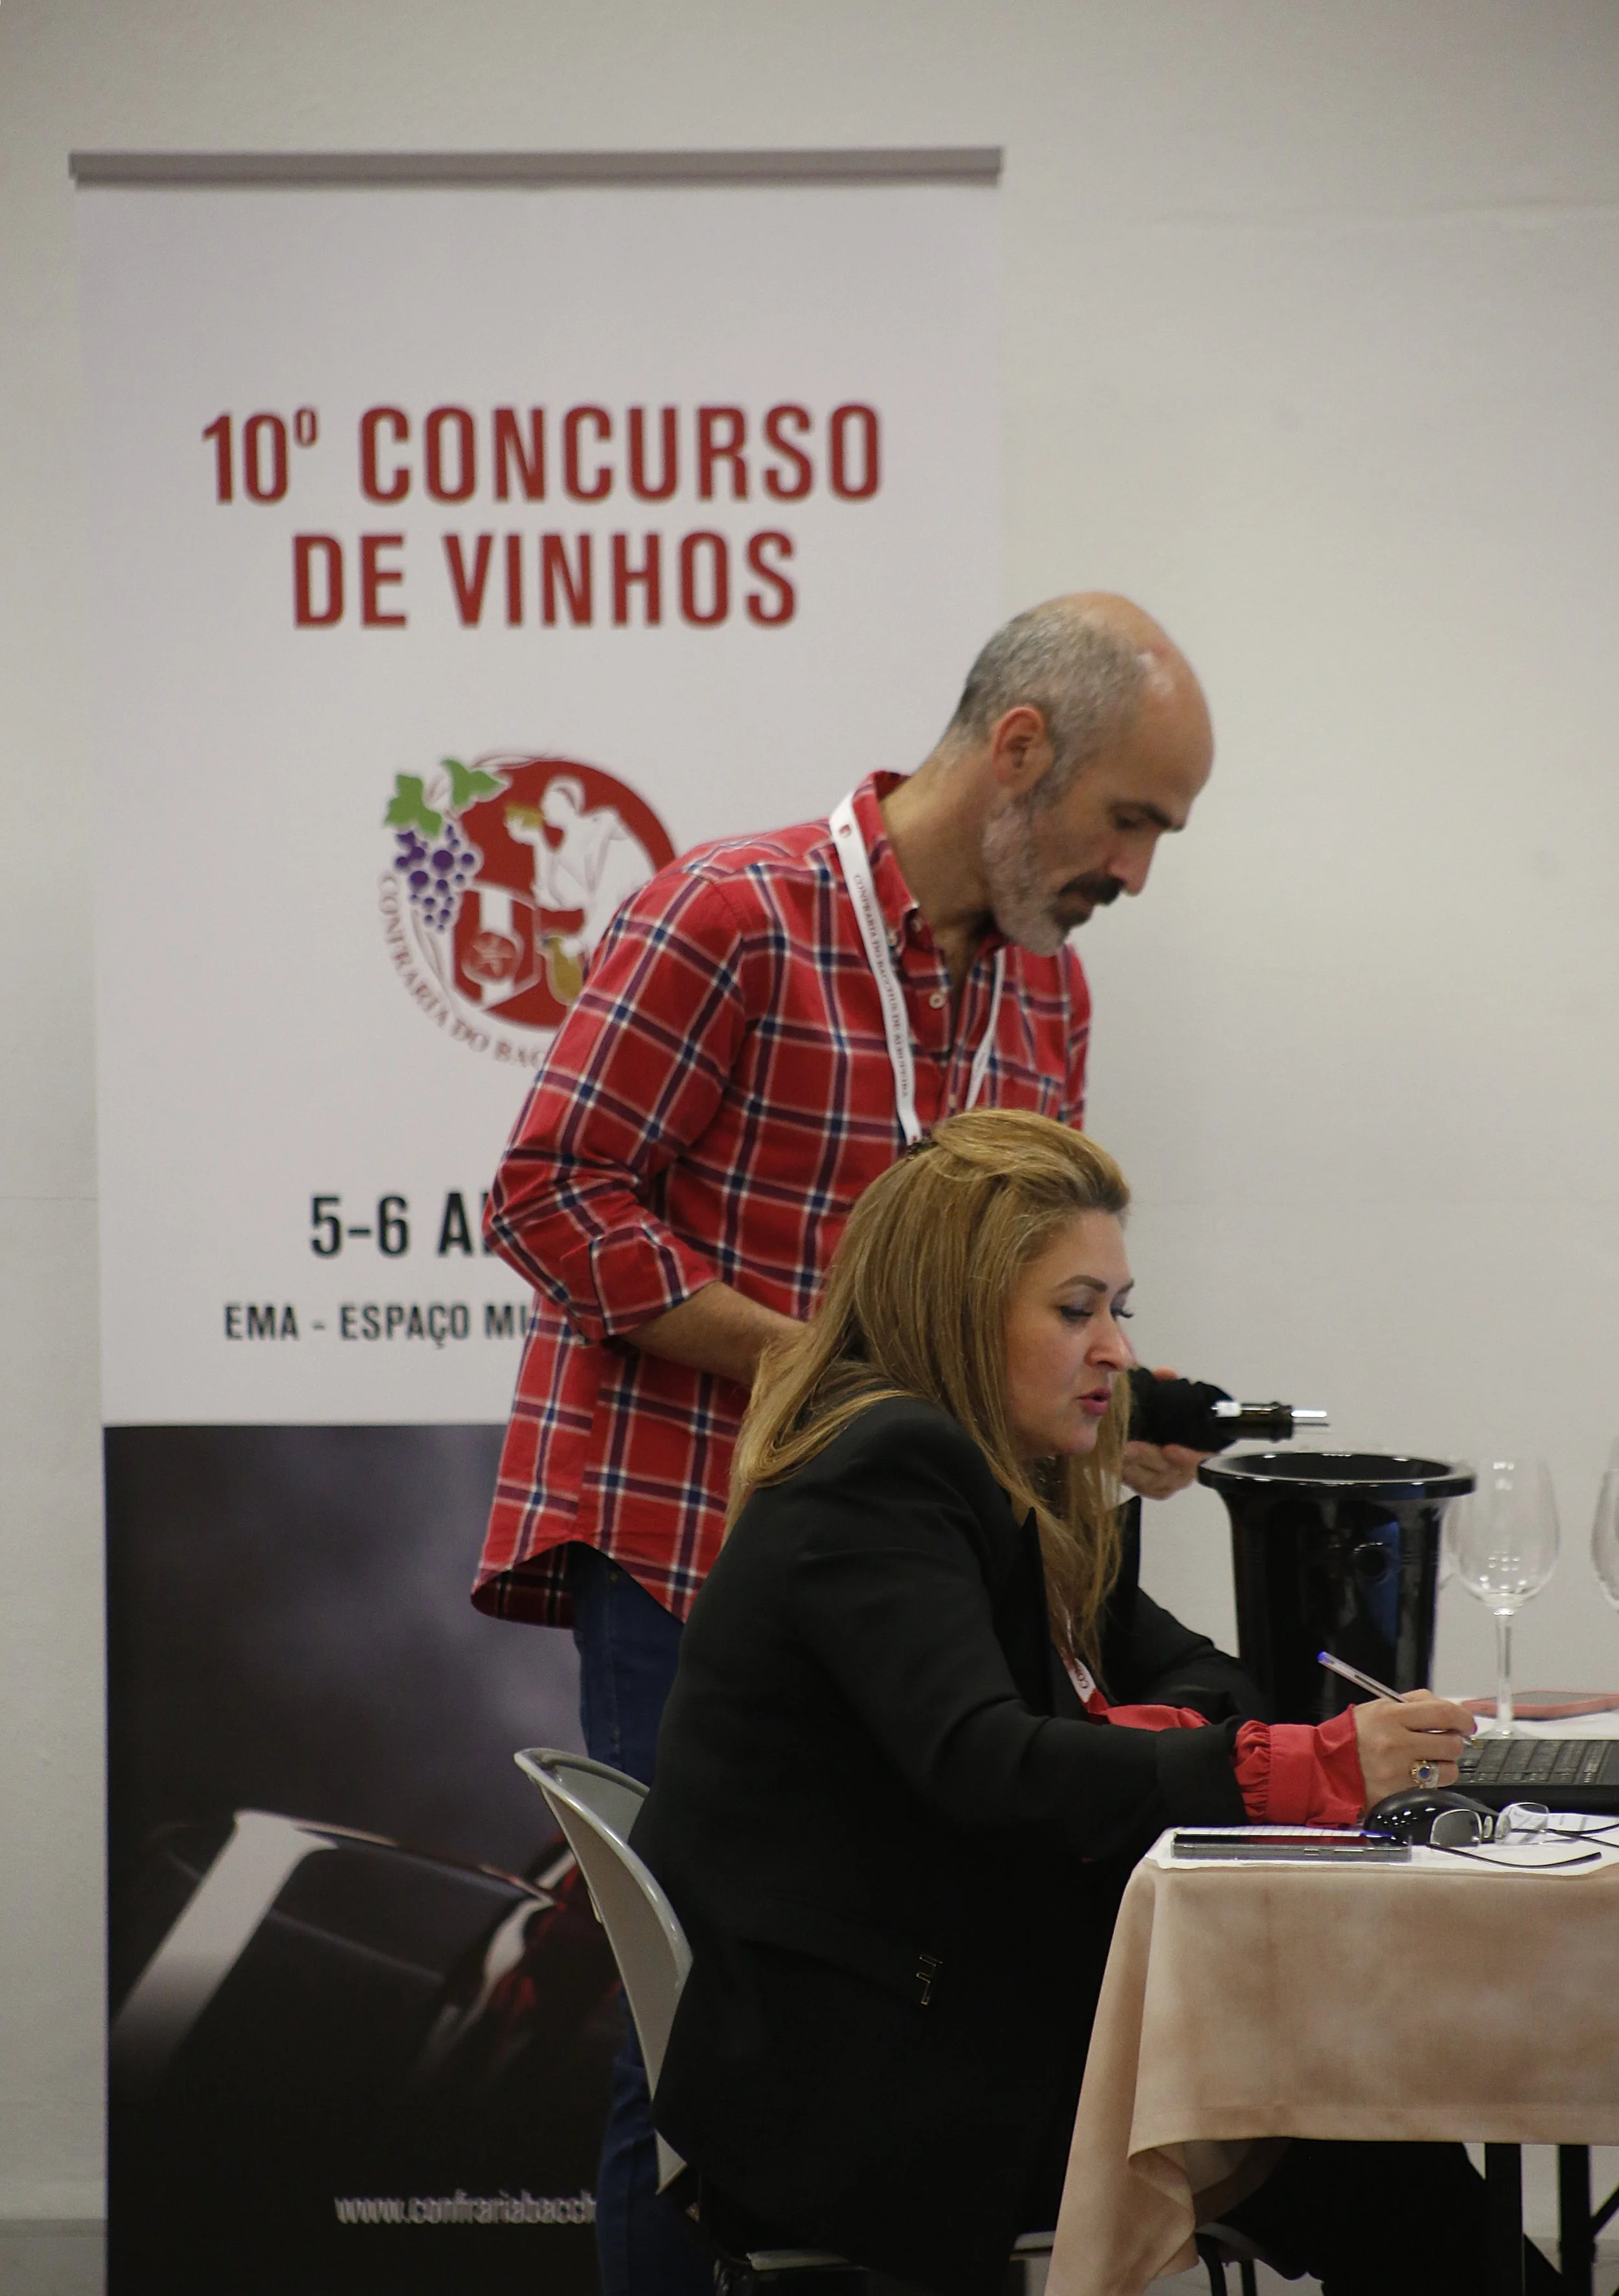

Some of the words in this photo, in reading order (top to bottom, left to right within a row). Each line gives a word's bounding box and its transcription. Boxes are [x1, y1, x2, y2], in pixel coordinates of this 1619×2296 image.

[359, 403, 881, 504] CONCURSO
[293, 534, 408, 629] DE
[442, 530, 797, 629] VINHOS
[379, 872, 449, 1028] CONFRARIA
[452, 1019, 488, 1052] DO
[310, 1194, 411, 1258] 5-6
[438, 1191, 496, 1256] A
[225, 1303, 300, 1341] EMA
[340, 1303, 469, 1349] ESPAÇO
